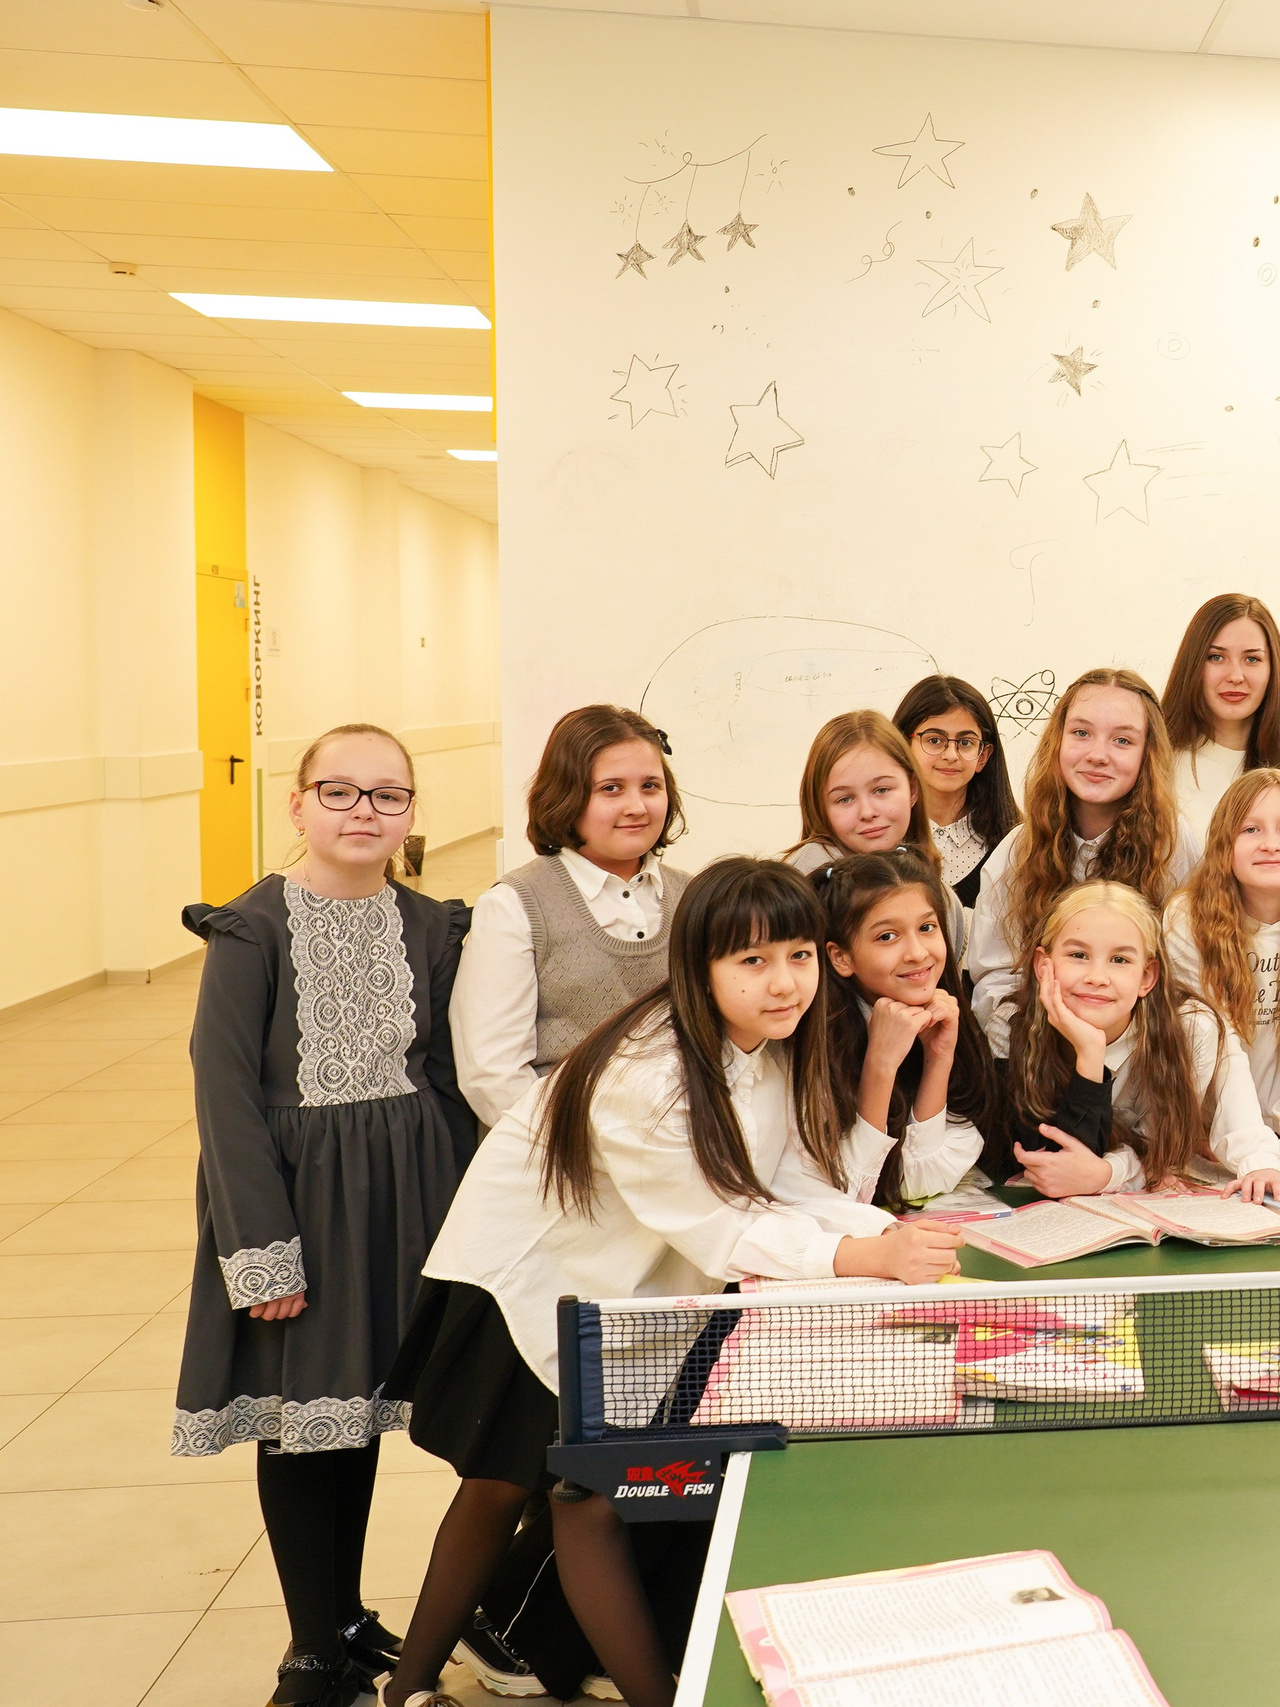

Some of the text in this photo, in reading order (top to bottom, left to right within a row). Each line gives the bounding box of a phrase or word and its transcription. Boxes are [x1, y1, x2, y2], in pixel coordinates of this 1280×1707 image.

[253, 574, 263, 736] КОВОРКИНГ
[614, 1483, 715, 1499] DOUBLE FISH
